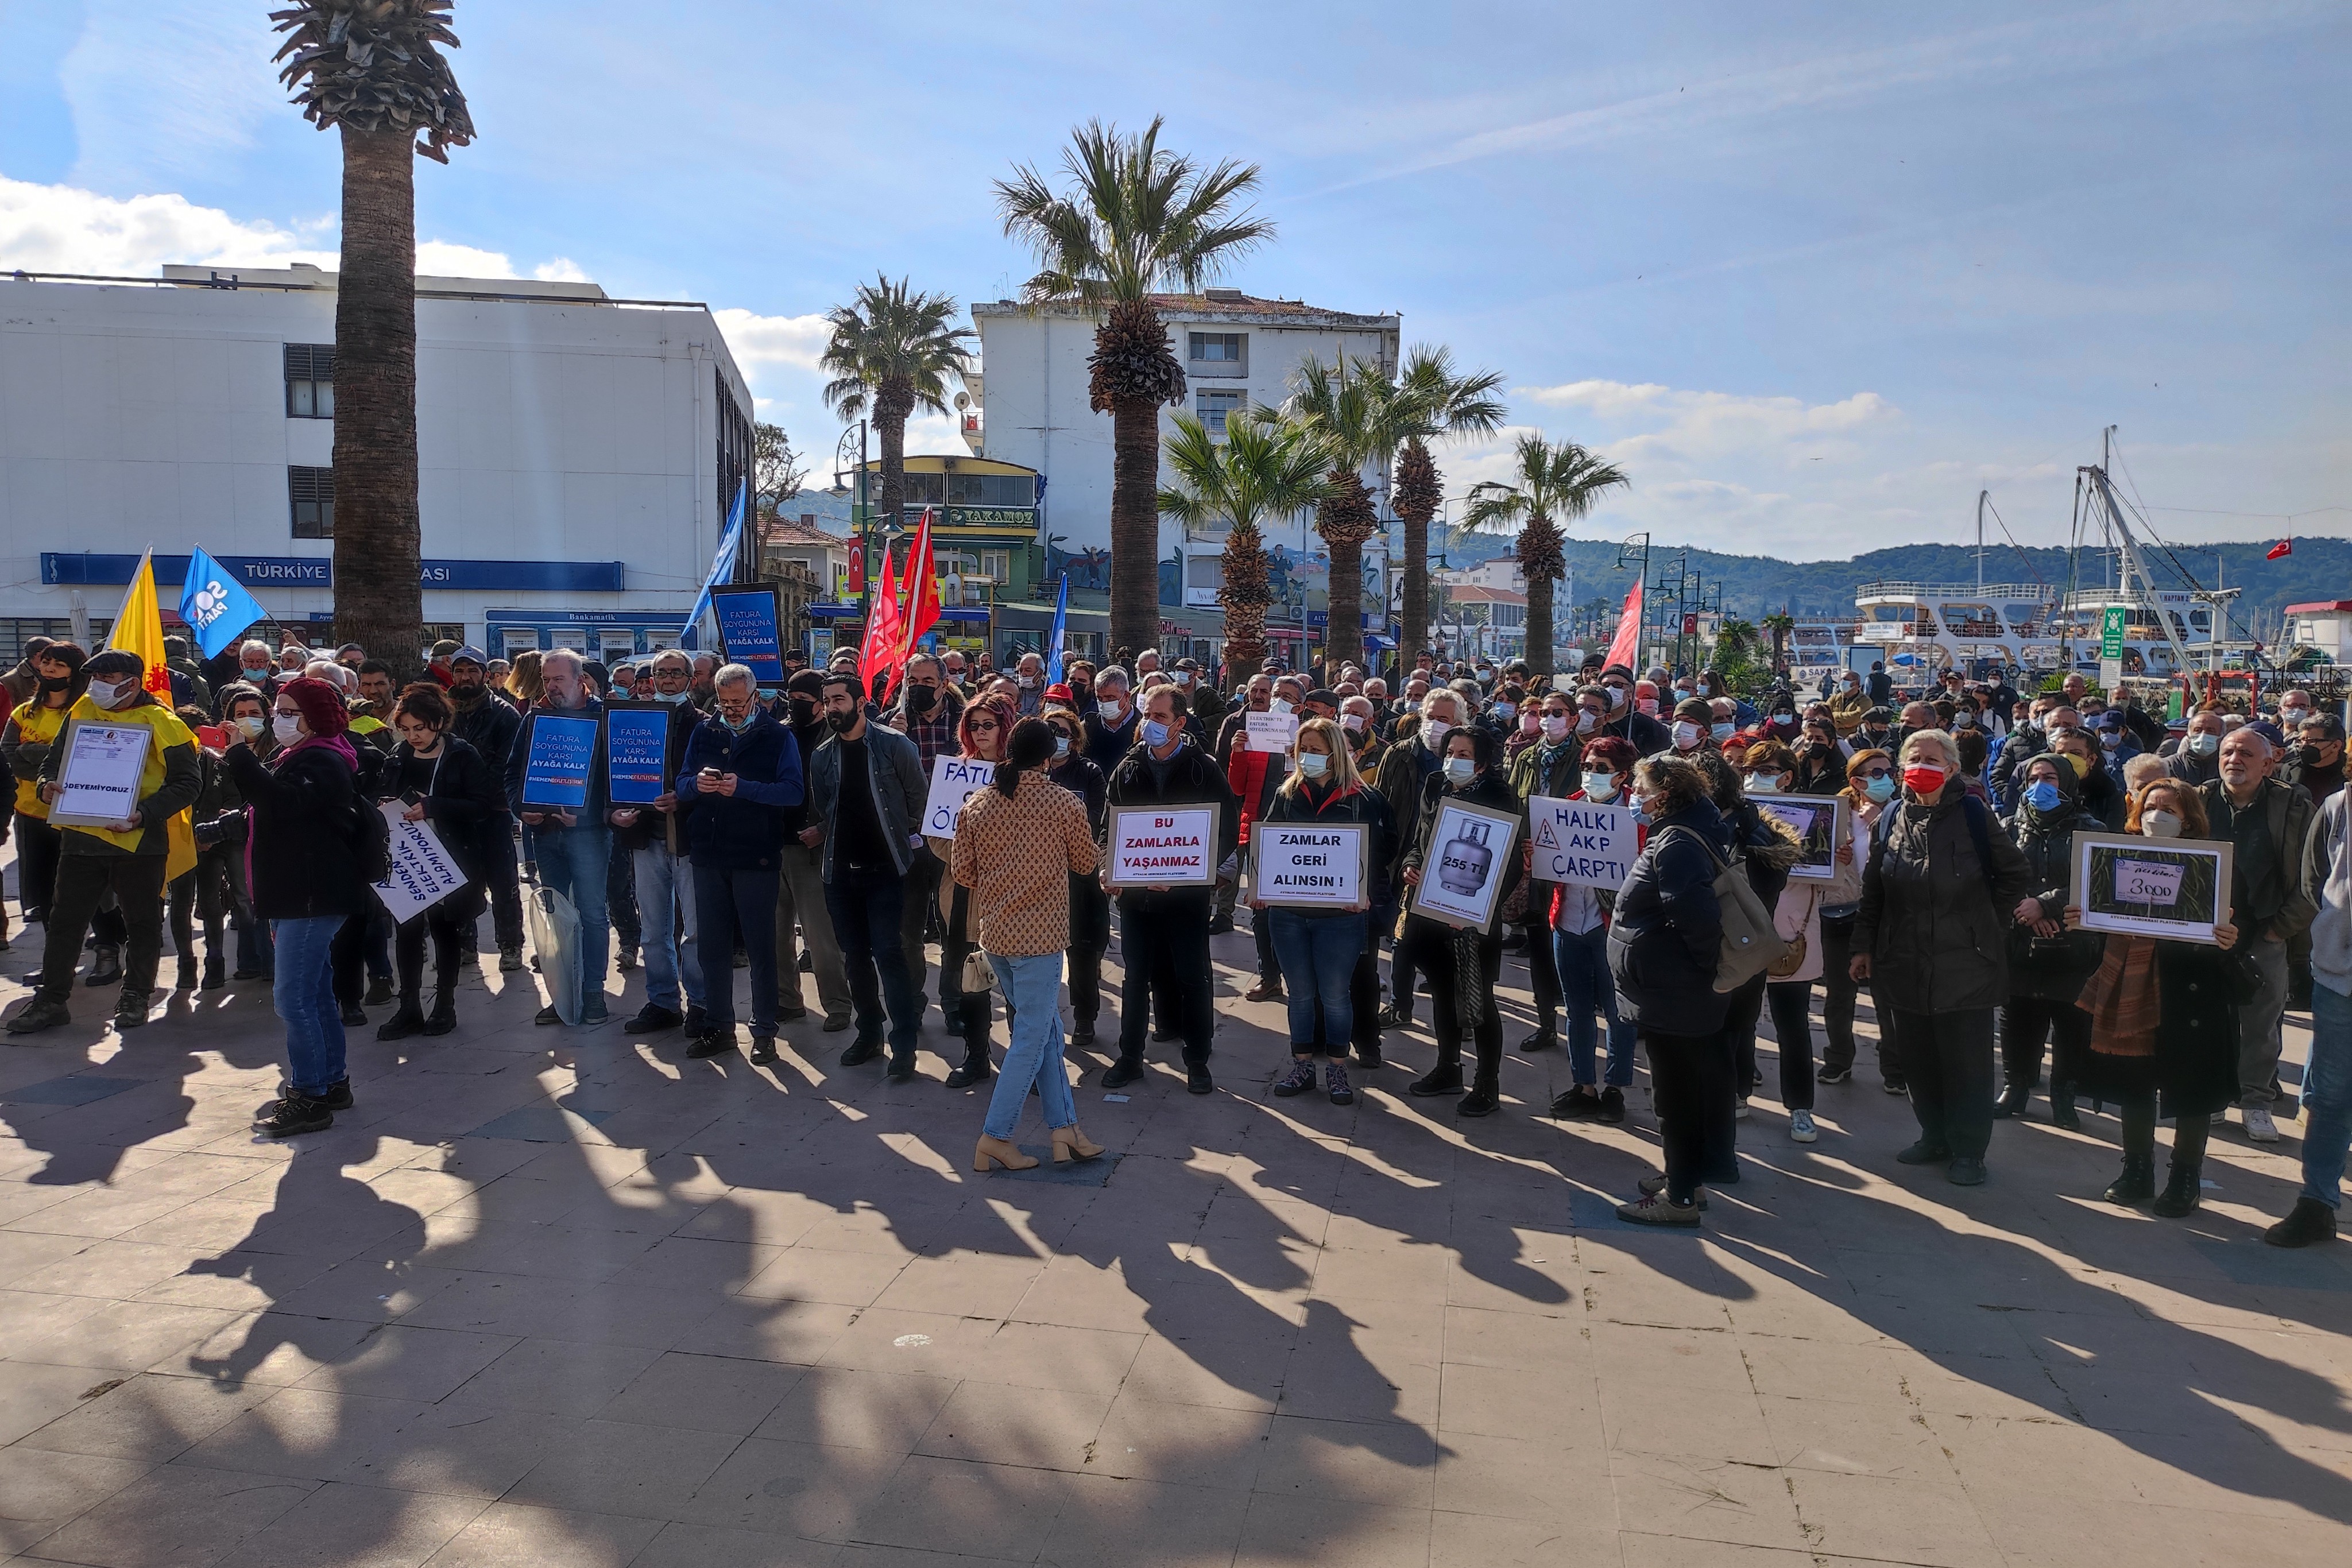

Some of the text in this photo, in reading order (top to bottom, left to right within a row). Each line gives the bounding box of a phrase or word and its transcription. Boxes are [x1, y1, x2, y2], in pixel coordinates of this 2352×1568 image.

[963, 510, 1034, 524] YAKAMOZ
[244, 562, 327, 578] TÜRKİYE
[724, 619, 772, 628] SOYGUNUNA
[737, 629, 759, 637] KARŞI
[728, 637, 753, 645] AYAĞA
[546, 734, 580, 744] FATURA
[612, 738, 660, 746] SOYGUNUNA
[535, 742, 588, 753] SOYGUNUNA
[625, 748, 647, 756] KARŞI
[548, 752, 572, 761] KARŞI
[612, 756, 639, 764] AYAĞA
[532, 760, 586, 770] AYAĞA KALK
[1155, 818, 1174, 828] BU
[1556, 808, 1615, 831] HALKI
[1125, 835, 1200, 849] ZAMLARLA
[1279, 834, 1341, 846] ZAMLAR
[1570, 834, 1610, 851] AKP
[398, 820, 457, 884] ALAMIYORUZ
[1123, 855, 1200, 869] YAŞANMAZ
[1291, 854, 1327, 866] GERİ
[1442, 856, 1467, 870] 255
[397, 840, 440, 893] ELEKTRİK
[1552, 855, 1626, 880] ÇARPTI
[392, 860, 426, 901] SENDEN
[1274, 874, 1343, 887] ALINSIN !
